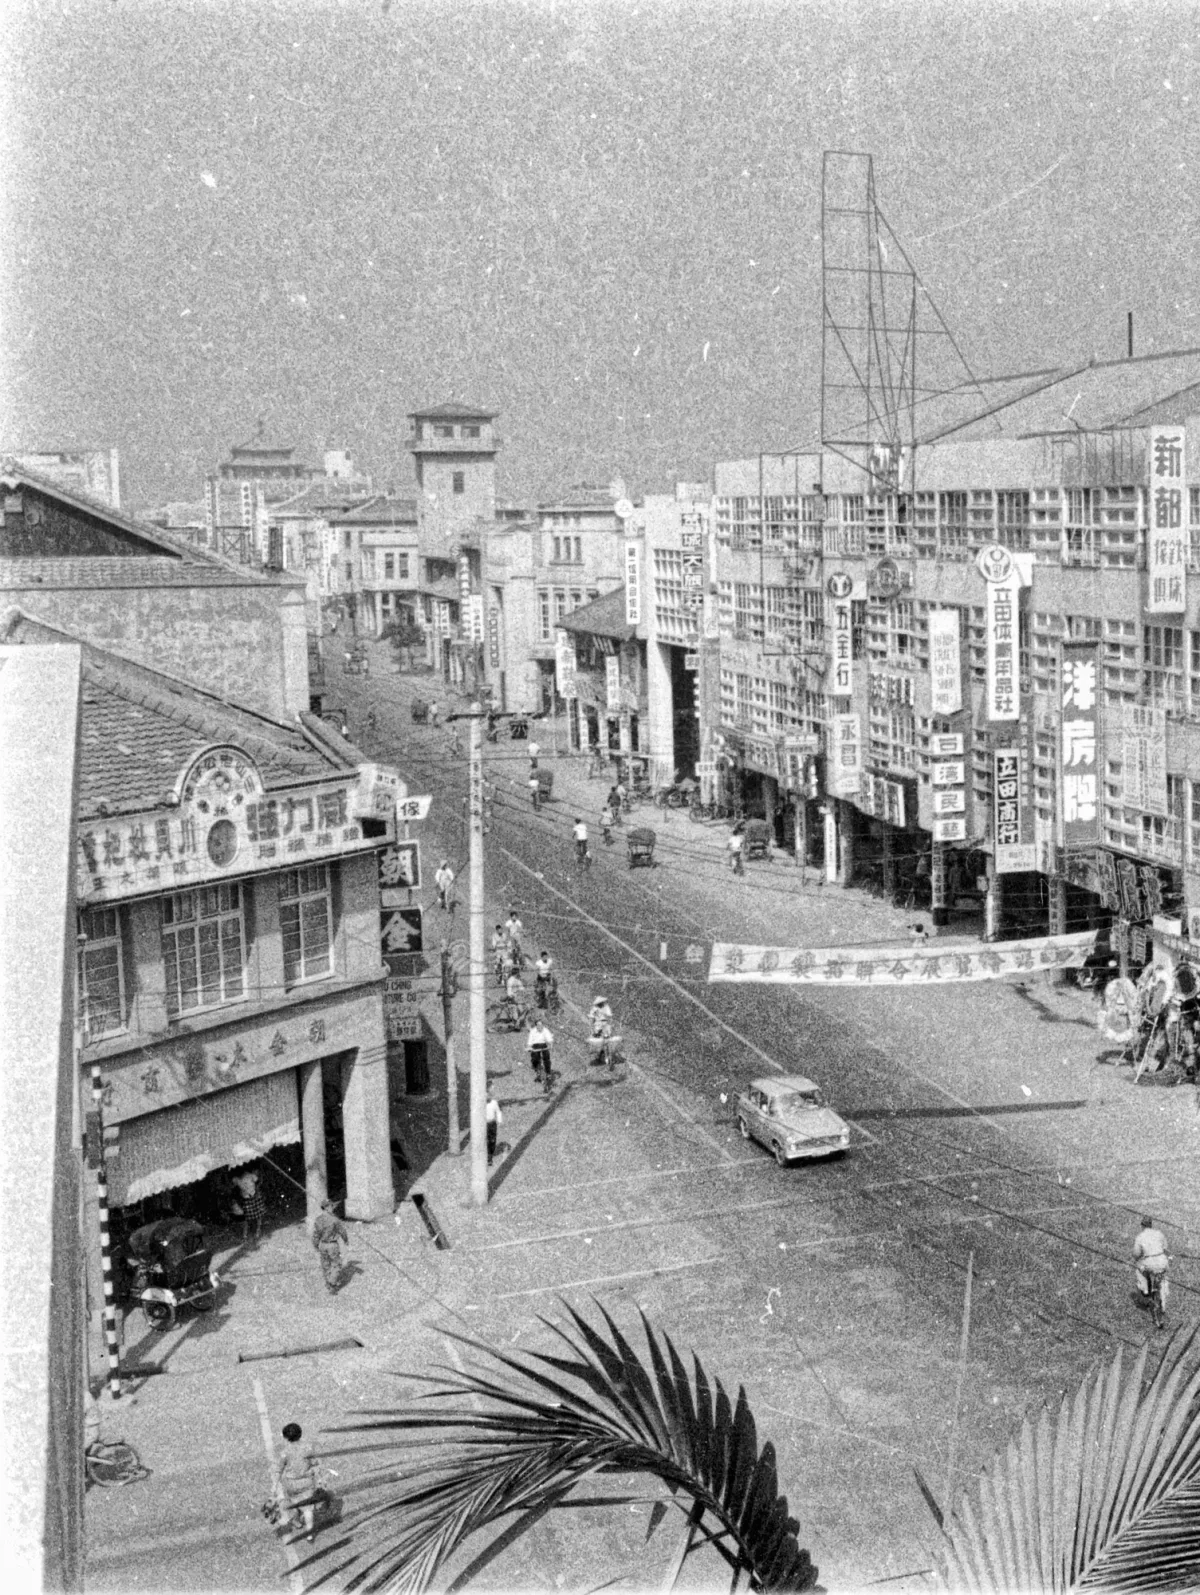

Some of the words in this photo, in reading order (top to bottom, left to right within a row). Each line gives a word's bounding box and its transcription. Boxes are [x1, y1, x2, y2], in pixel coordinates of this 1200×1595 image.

[1154, 434, 1183, 529] 新都
[835, 605, 850, 687] 五金行
[1063, 660, 1096, 822] 洋房牌
